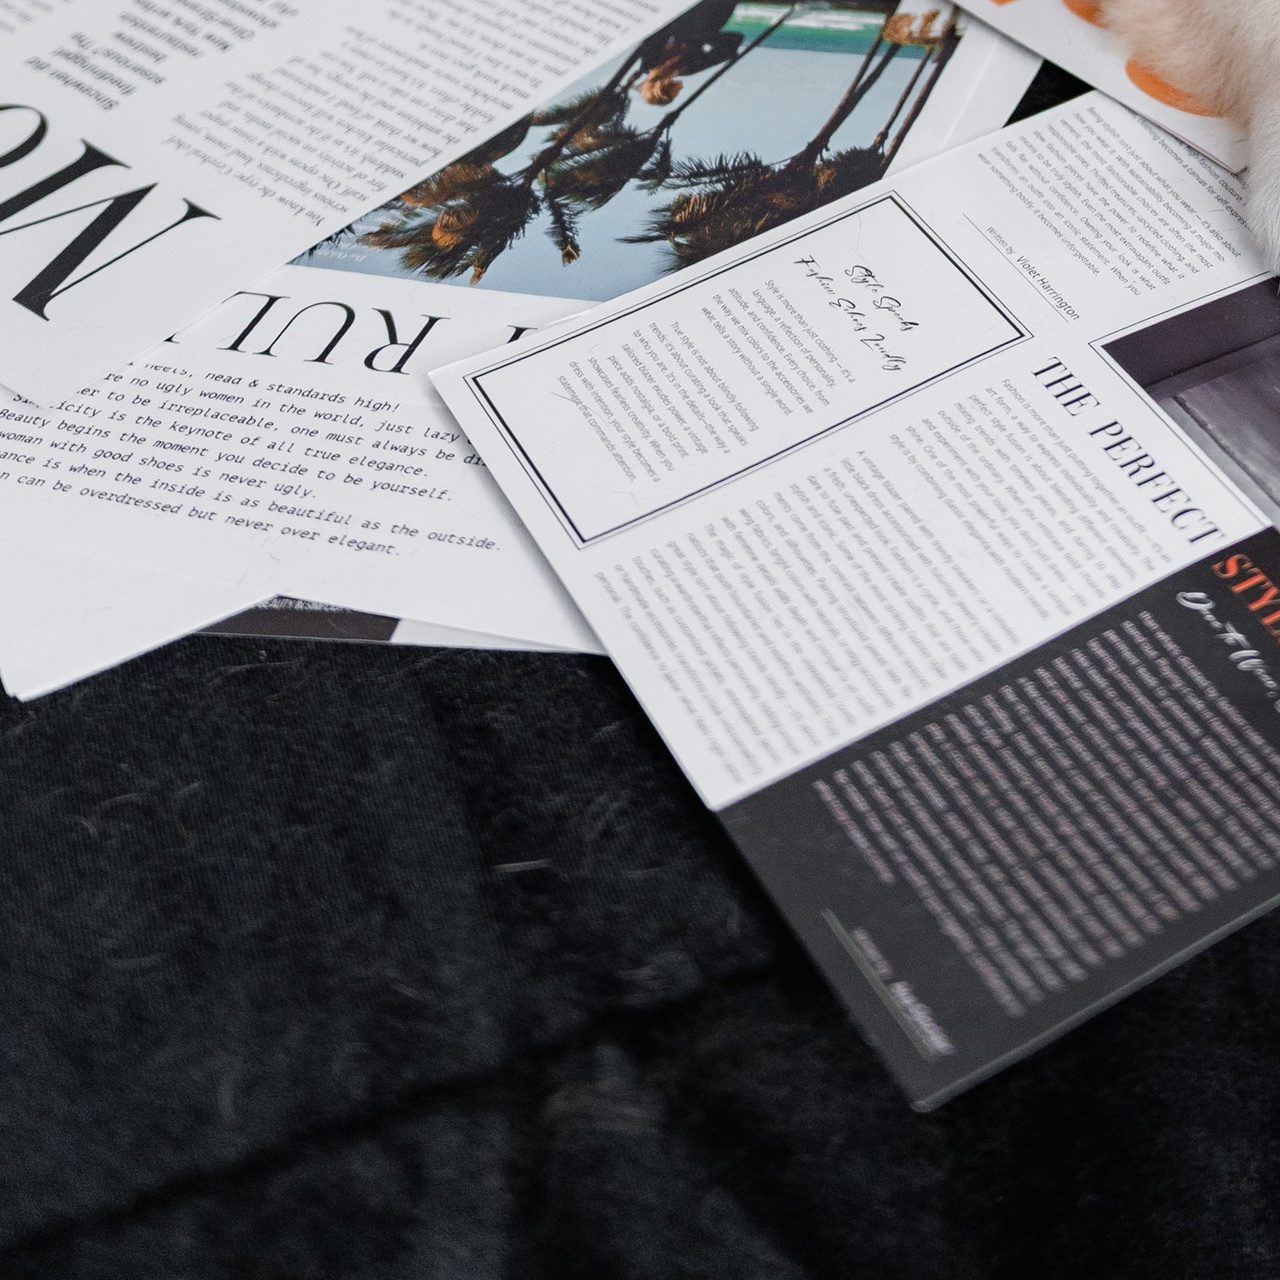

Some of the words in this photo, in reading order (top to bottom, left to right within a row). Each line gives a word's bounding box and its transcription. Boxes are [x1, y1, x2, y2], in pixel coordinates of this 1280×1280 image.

[792, 254, 835, 294] Fashion
[828, 297, 867, 331] Echoes
[860, 333, 906, 370] Loudly
[844, 264, 884, 292] Style
[872, 295, 919, 331] Speaks
[986, 226, 1007, 247] Written
[1005, 246, 1015, 254] by
[1016, 255, 1040, 278] Violet
[1036, 277, 1079, 320] Harrington
[712, 294, 723, 304] the
[721, 303, 733, 316] way
[730, 315, 740, 325] we
[737, 324, 749, 336] mix
[746, 336, 764, 354] colors
[760, 352, 769, 360] to
[766, 360, 778, 371] the
[775, 371, 805, 404] accessories
[802, 403, 813, 413] we
[713, 321, 726, 334] tells
[726, 338, 742, 353] story
[738, 353, 760, 376] without
[760, 380, 778, 398] single
[747, 311, 762, 322] and
[783, 352, 799, 370] Every
[814, 389, 829, 405] from
[764, 279, 779, 294] Style
[781, 299, 796, 314] more
[794, 313, 808, 328] than
[802, 327, 818, 339] just
[814, 338, 837, 363] clothing
[777, 321, 803, 348] reflection
[107, 391, 124, 401] to
[131, 394, 150, 406] be
[158, 400, 277, 431] irreplaceable,
[290, 426, 318, 437] one
[325, 432, 363, 445] must
[371, 440, 427, 456] always
[435, 448, 454, 460] be
[129, 377, 148, 386] no
[156, 382, 192, 396] ugly
[199, 390, 244, 403] women
[251, 398, 270, 408] in
[279, 403, 306, 415] the
[313, 411, 363, 427] world,
[374, 420, 413, 434] just
[423, 427, 463, 444] lazy
[248, 379, 258, 387] &
[266, 383, 346, 403] standards
[353, 396, 399, 412] high!
[49, 440, 86, 453] with
[91, 449, 133, 462] good
[138, 456, 183, 472] shoes
[192, 466, 211, 477] is
[218, 473, 266, 487] never
[274, 483, 315, 498] ugly.
[57, 419, 110, 437] begins
[119, 432, 146, 444] the
[152, 440, 208, 456] moment
[214, 452, 245, 463] you
[252, 457, 307, 475] decide
[317, 470, 335, 480] to
[343, 473, 362, 485] be
[369, 480, 450, 500] yourself.
[107, 410, 126, 420] is
[135, 415, 161, 427] the
[168, 420, 232, 440] keynote
[240, 436, 261, 445] of
[266, 441, 294, 452] all
[304, 447, 340, 460] true
[348, 455, 426, 476] elegance.
[1031, 356, 1100, 416] THE
[1087, 419, 1224, 544] PERFECT
[17, 475, 45, 486] can
[52, 479, 71, 492] be
[79, 487, 183, 513] overdressed
[187, 506, 217, 520] but
[224, 516, 273, 531] never
[280, 526, 320, 540] over
[327, 534, 398, 555] elegant.
[42, 457, 61, 469] is
[68, 463, 105, 477] when
[114, 472, 141, 484] the
[149, 478, 205, 497] inside
[212, 490, 232, 502] is
[240, 498, 259, 507] as
[267, 500, 351, 524] beautiful
[361, 520, 380, 529] as
[390, 524, 418, 536] the
[427, 532, 499, 550] outside.
